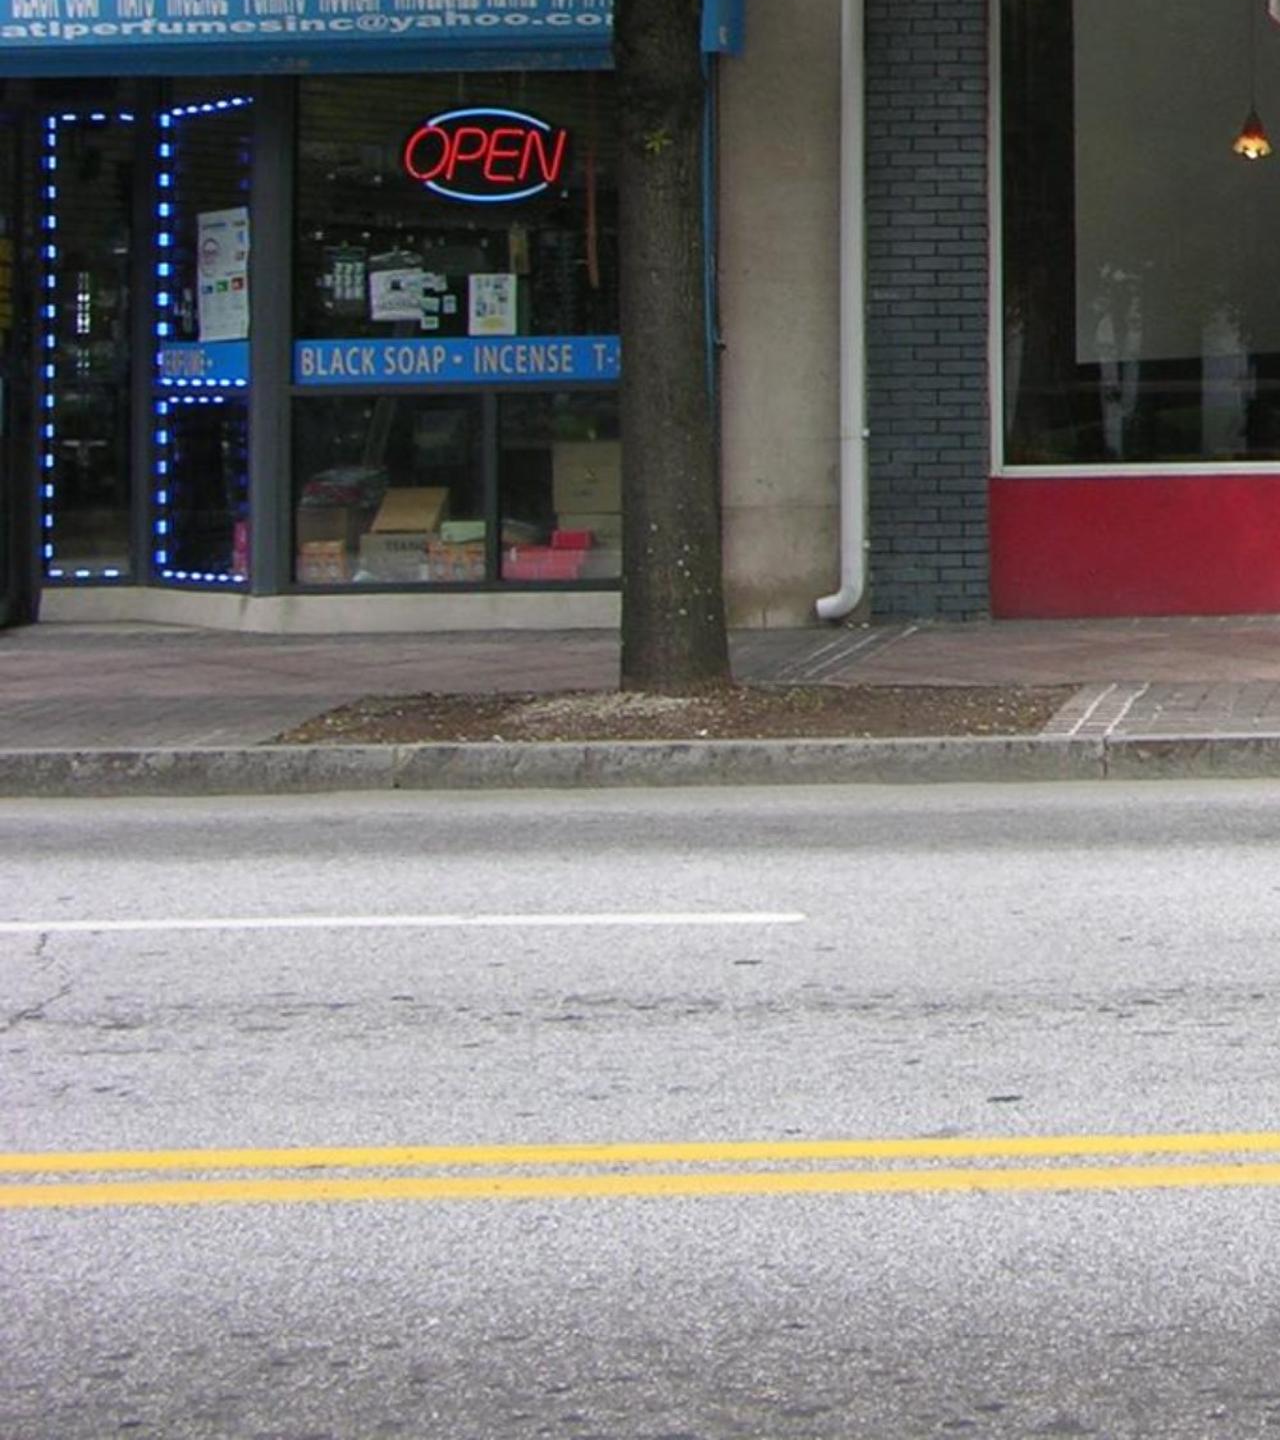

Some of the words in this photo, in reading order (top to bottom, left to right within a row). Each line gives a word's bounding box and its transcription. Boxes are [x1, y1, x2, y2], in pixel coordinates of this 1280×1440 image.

[405, 126, 567, 182] OPEN
[300, 347, 375, 376] BLACK
[383, 345, 446, 374] SOAP
[473, 344, 573, 374] INCENSE
